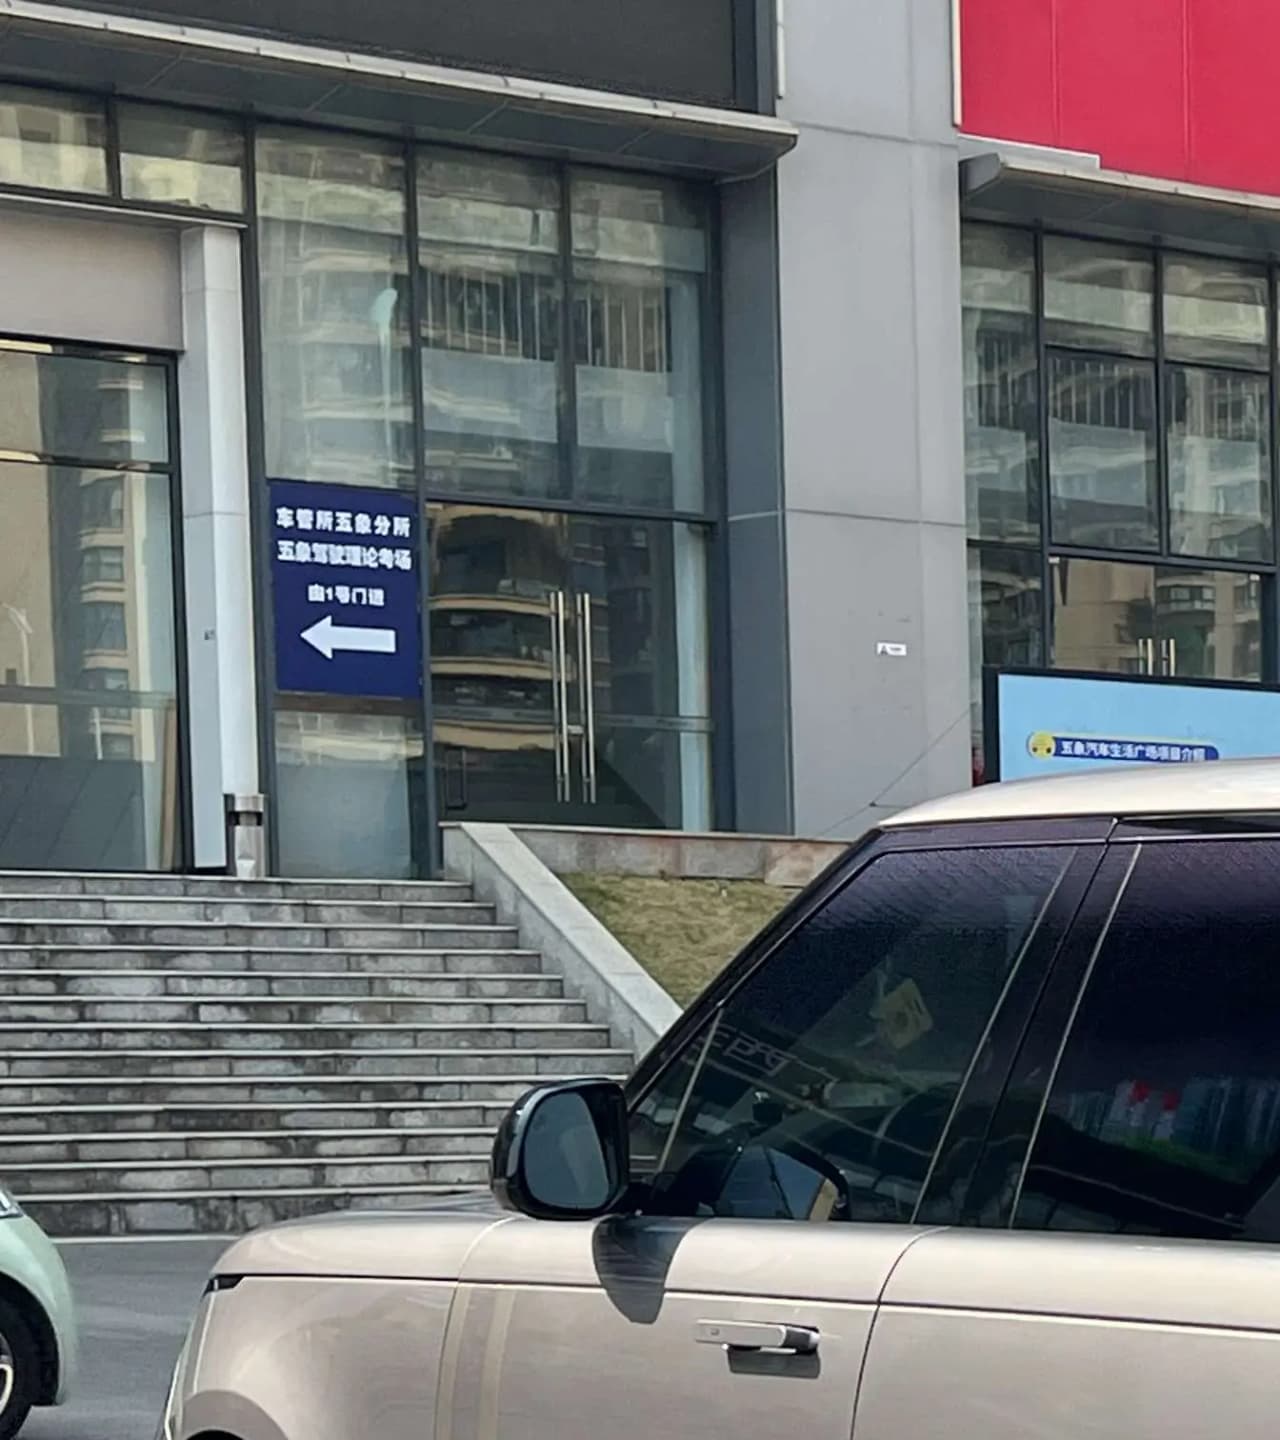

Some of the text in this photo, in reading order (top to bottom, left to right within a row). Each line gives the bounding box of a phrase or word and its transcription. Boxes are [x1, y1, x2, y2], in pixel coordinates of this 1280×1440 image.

[275, 506, 411, 538] 车管所五象分所
